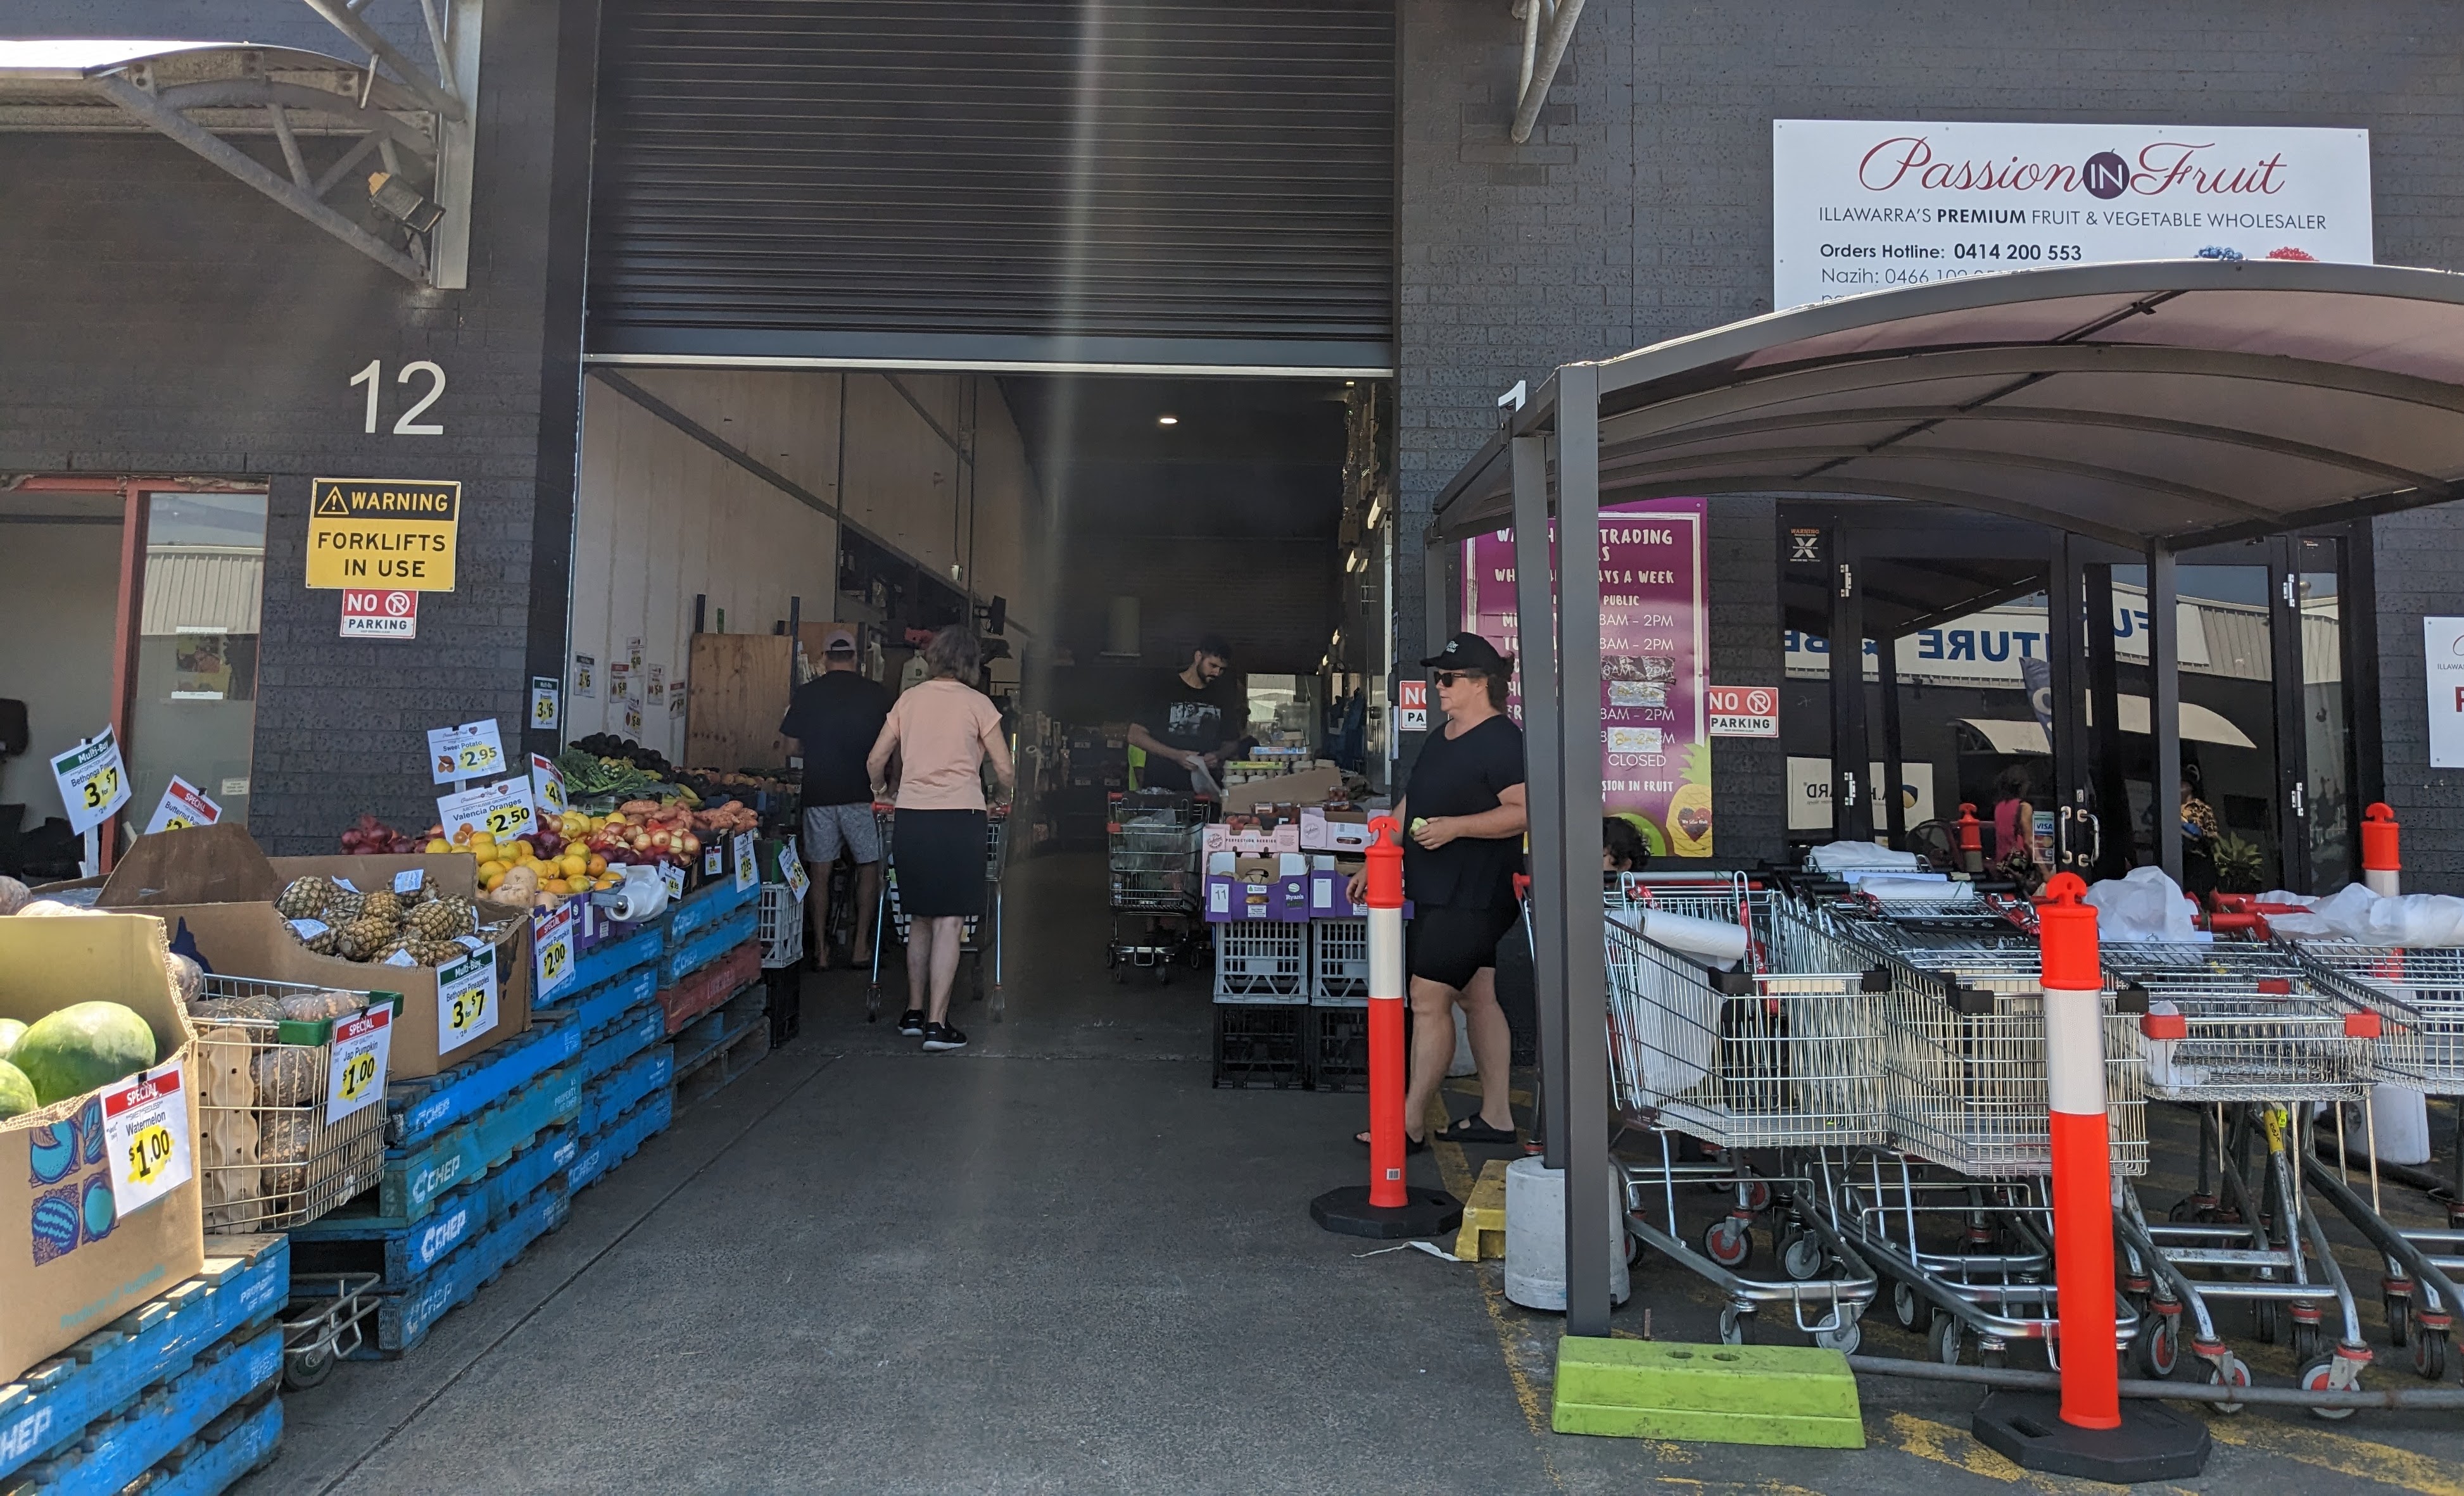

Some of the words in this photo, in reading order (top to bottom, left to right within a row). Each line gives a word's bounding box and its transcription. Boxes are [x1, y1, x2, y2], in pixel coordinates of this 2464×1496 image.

[1859, 135, 2084, 194] Passion
[2090, 163, 2125, 192] IN
[2129, 142, 2287, 195] Fruit
[1819, 206, 1931, 223] ILLAWARRA'S
[1938, 209, 2026, 225] PREMIUM
[2031, 210, 2080, 225] FRUIT
[2085, 211, 2099, 226] &
[2103, 211, 2202, 228] VEGETABLE
[2207, 213, 2326, 230] WHOLESALER
[1820, 244, 1876, 258] Orders
[1883, 244, 1945, 259] Hotline:
[1954, 243, 2000, 260] 0414
[2007, 244, 2041, 260] 200
[2047, 245, 2082, 261] 553
[1822, 268, 1880, 284] Nazih:
[1885, 268, 1929, 284] 0466
[350, 359, 447, 435] 12
[351, 491, 448, 512] WARNING
[317, 532, 446, 552] FORKLIFTS
[1600, 529, 1673, 544] TRADING
[344, 560, 367, 577] IN
[379, 560, 426, 578] USE
[1624, 570, 1633, 584] A
[1638, 570, 1675, 584] WEEK
[348, 593, 377, 612] NO
[1603, 594, 1640, 607] PUBLIC
[348, 619, 407, 630] PARKING
[1599, 614, 1629, 627] 8AM
[1644, 614, 1674, 627] 2PM
[1600, 638, 1629, 650] 8AM
[1644, 638, 1674, 651] 2PM
[1709, 692, 1738, 710] NO
[1600, 708, 1630, 720] 8AM
[1645, 708, 1675, 721] 2PM
[1711, 717, 1770, 729] PARKING
[78, 740, 109, 764] Multi-Buy
[459, 746, 498, 767] $2.95
[1608, 753, 1667, 767] CLOSED
[70, 768, 100, 788] Bethonga
[84, 782, 101, 808] 3
[106, 766, 118, 792] $7
[1602, 780, 1625, 791] SION
[1628, 780, 1640, 791] IN
[1644, 780, 1674, 792] FRUIT
[165, 801, 191, 822] Butternut
[453, 808, 488, 821] Valencia
[489, 798, 522, 812] Oranges
[486, 807, 530, 833] $2.50
[1215, 889, 1227, 900] 11
[455, 959, 481, 978] Multi-Buy
[544, 943, 565, 976] $2.00
[446, 986, 467, 1002] Bethonga
[468, 976, 490, 992] Pineapples
[453, 1000, 464, 1028] 3
[471, 988, 485, 1017] $7
[349, 1017, 374, 1036] SPECIAL
[343, 1050, 353, 1062] Jap
[355, 1041, 378, 1057] Pumpkin
[343, 1057, 375, 1097] $1.00
[127, 1081, 158, 1107] SPECIAL
[126, 1110, 166, 1137] Watermelon
[129, 1129, 170, 1179] $1.00
[0, 1405, 53, 1467] HEP
